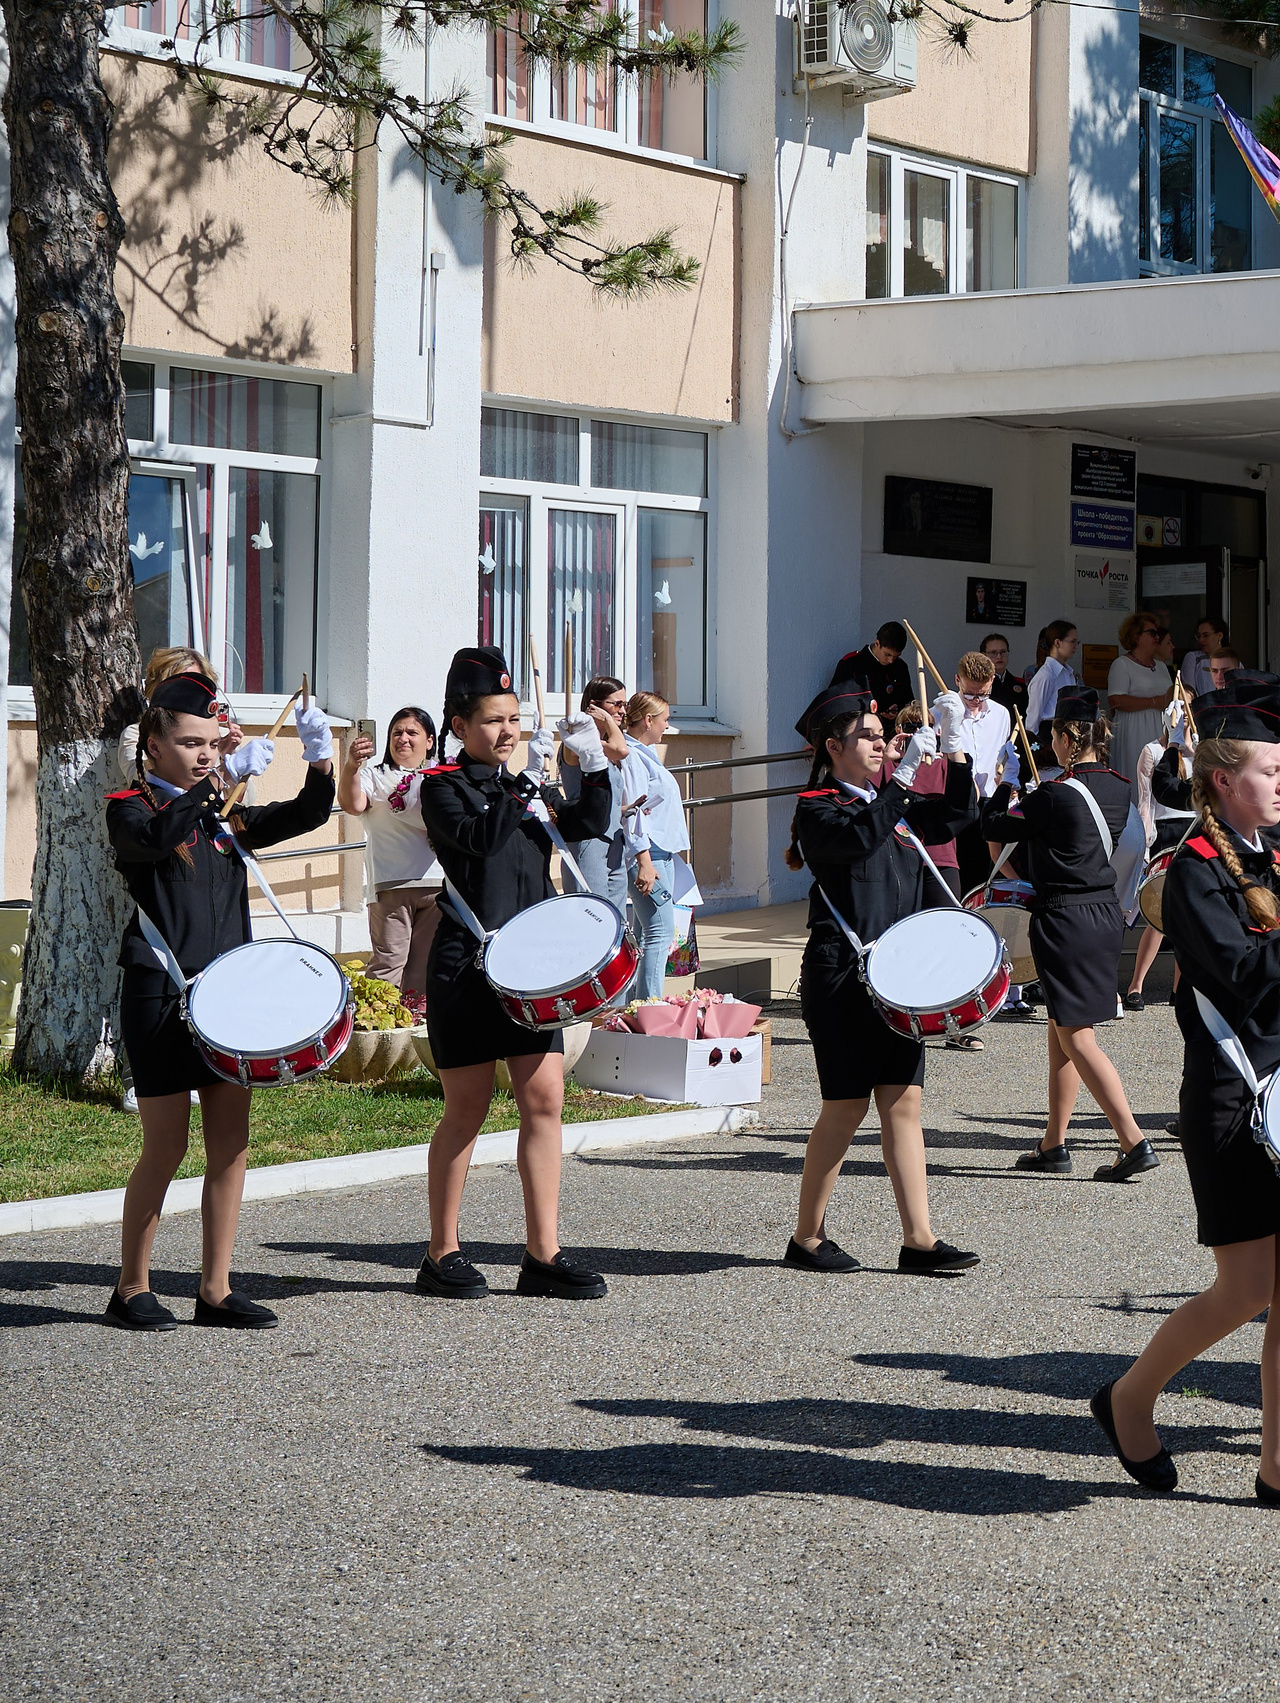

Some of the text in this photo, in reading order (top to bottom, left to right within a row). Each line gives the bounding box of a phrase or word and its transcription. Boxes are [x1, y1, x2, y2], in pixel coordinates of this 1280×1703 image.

[1078, 508, 1095, 518] Школа
[1077, 569, 1129, 582] ТОЧКА РОСТА
